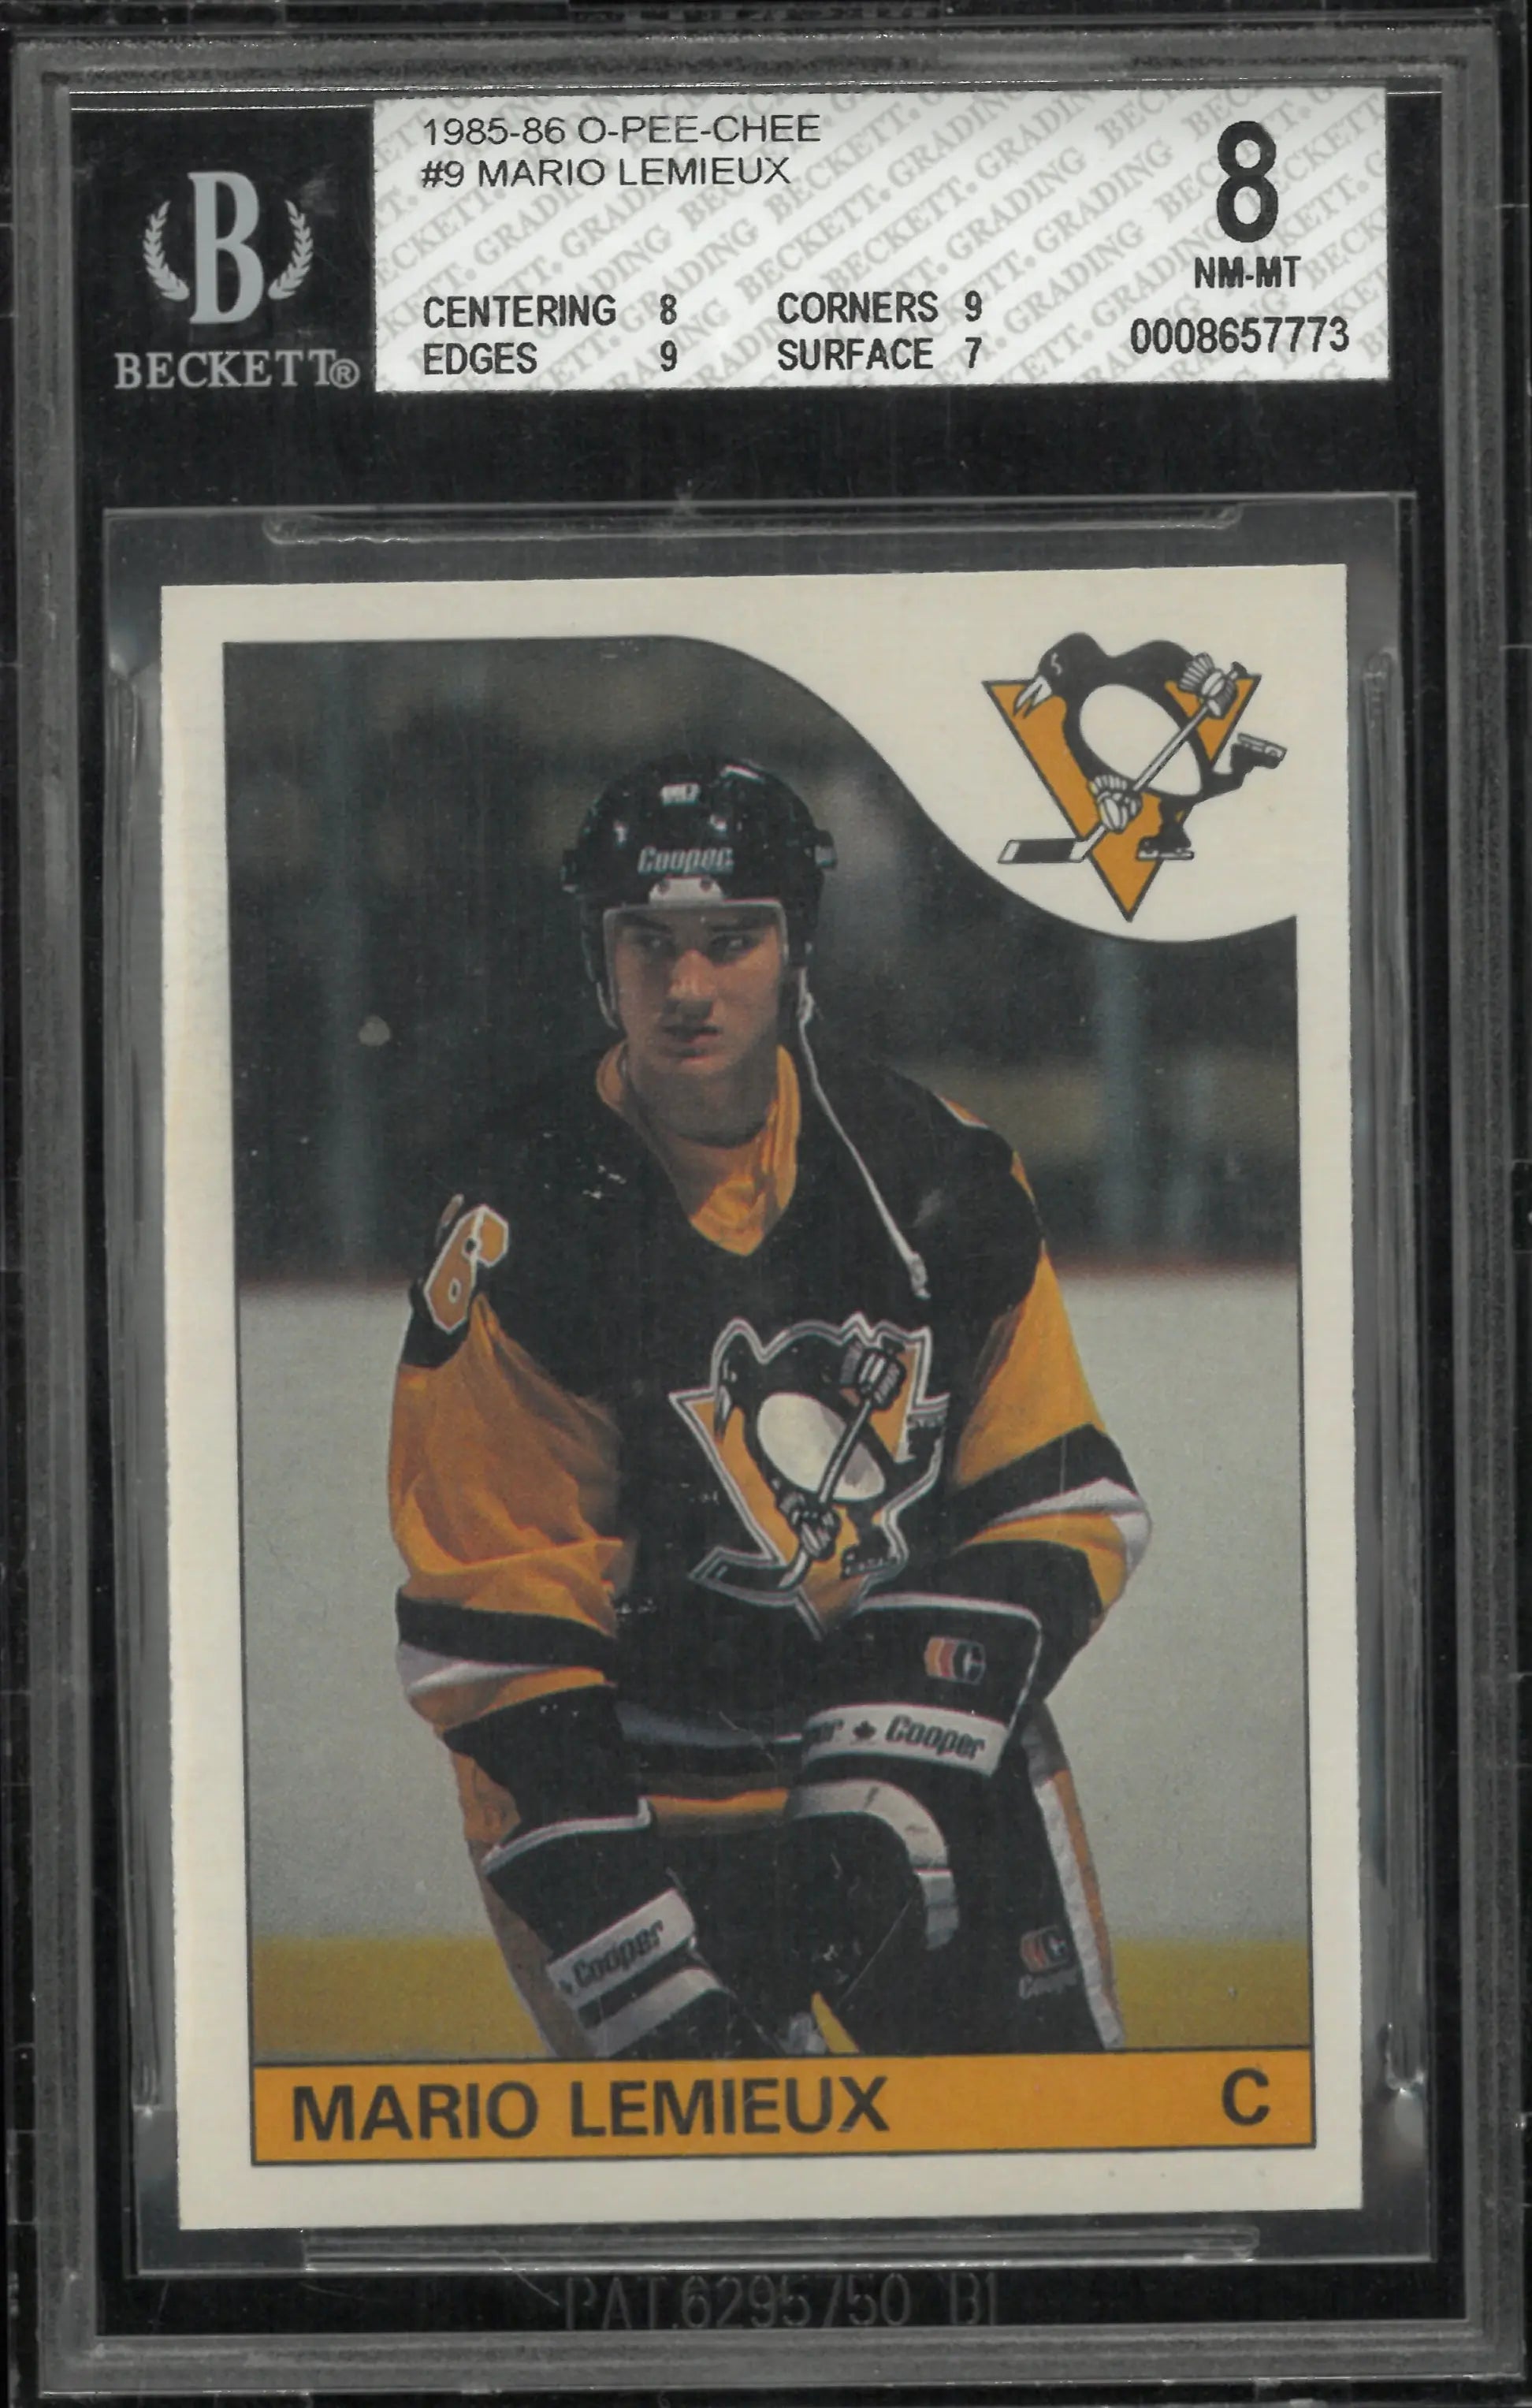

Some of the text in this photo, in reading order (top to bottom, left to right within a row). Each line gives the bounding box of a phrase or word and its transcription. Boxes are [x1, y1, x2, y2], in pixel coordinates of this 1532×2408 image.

[425, 117, 564, 145] 1985-86
[578, 115, 820, 143] O-PEE-CHEE
[422, 158, 789, 187] #9 MARIO LEMIEUX
[1217, 121, 1277, 242] 8
[1195, 256, 1300, 288] NM-MT
[424, 295, 676, 327] CENTERING 8
[778, 291, 981, 323] CORNERS 9
[1132, 316, 1348, 353] 0008657773
[425, 343, 537, 374] EDGES
[661, 341, 676, 371] 9
[779, 338, 932, 370] SURFACE
[965, 337, 981, 368] 7
[885, 1714, 985, 1760] Cooper
[572, 1919, 664, 1989] Cooper
[294, 2069, 1269, 2141] MARIO LEMIEUX C
